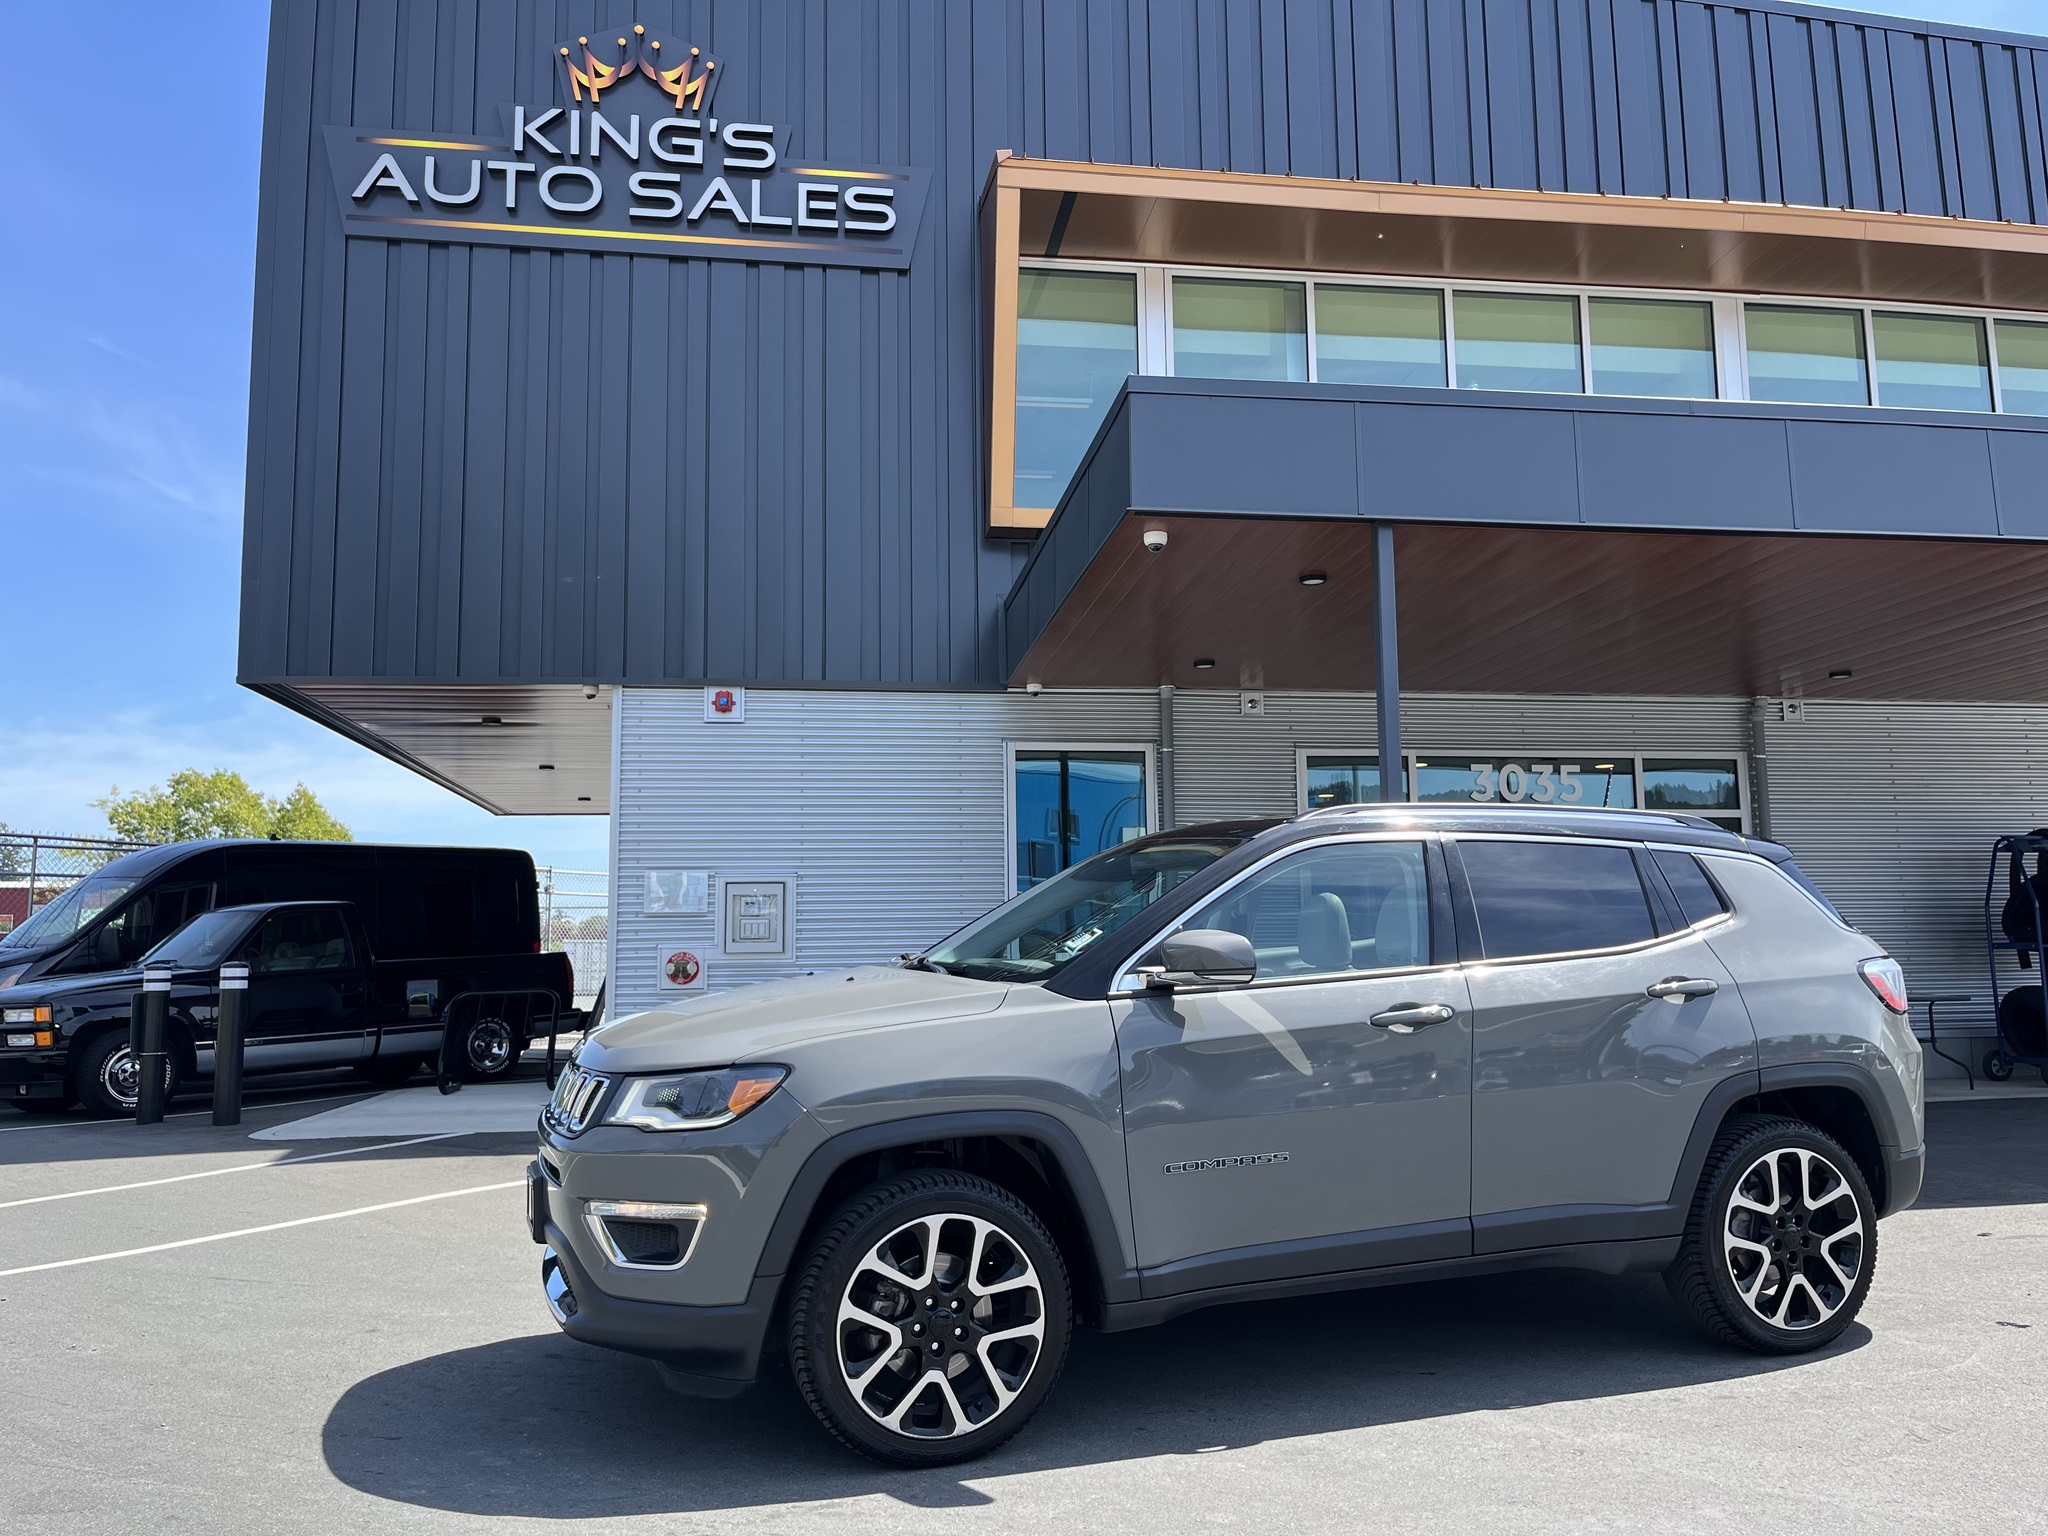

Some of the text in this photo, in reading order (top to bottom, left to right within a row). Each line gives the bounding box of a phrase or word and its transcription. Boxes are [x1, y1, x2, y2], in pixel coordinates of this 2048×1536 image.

[513, 104, 777, 172] KING'S
[351, 152, 898, 234] AUTO SALES
[1469, 763, 1584, 803] 3035
[1162, 1150, 1291, 1175] COMPASS
